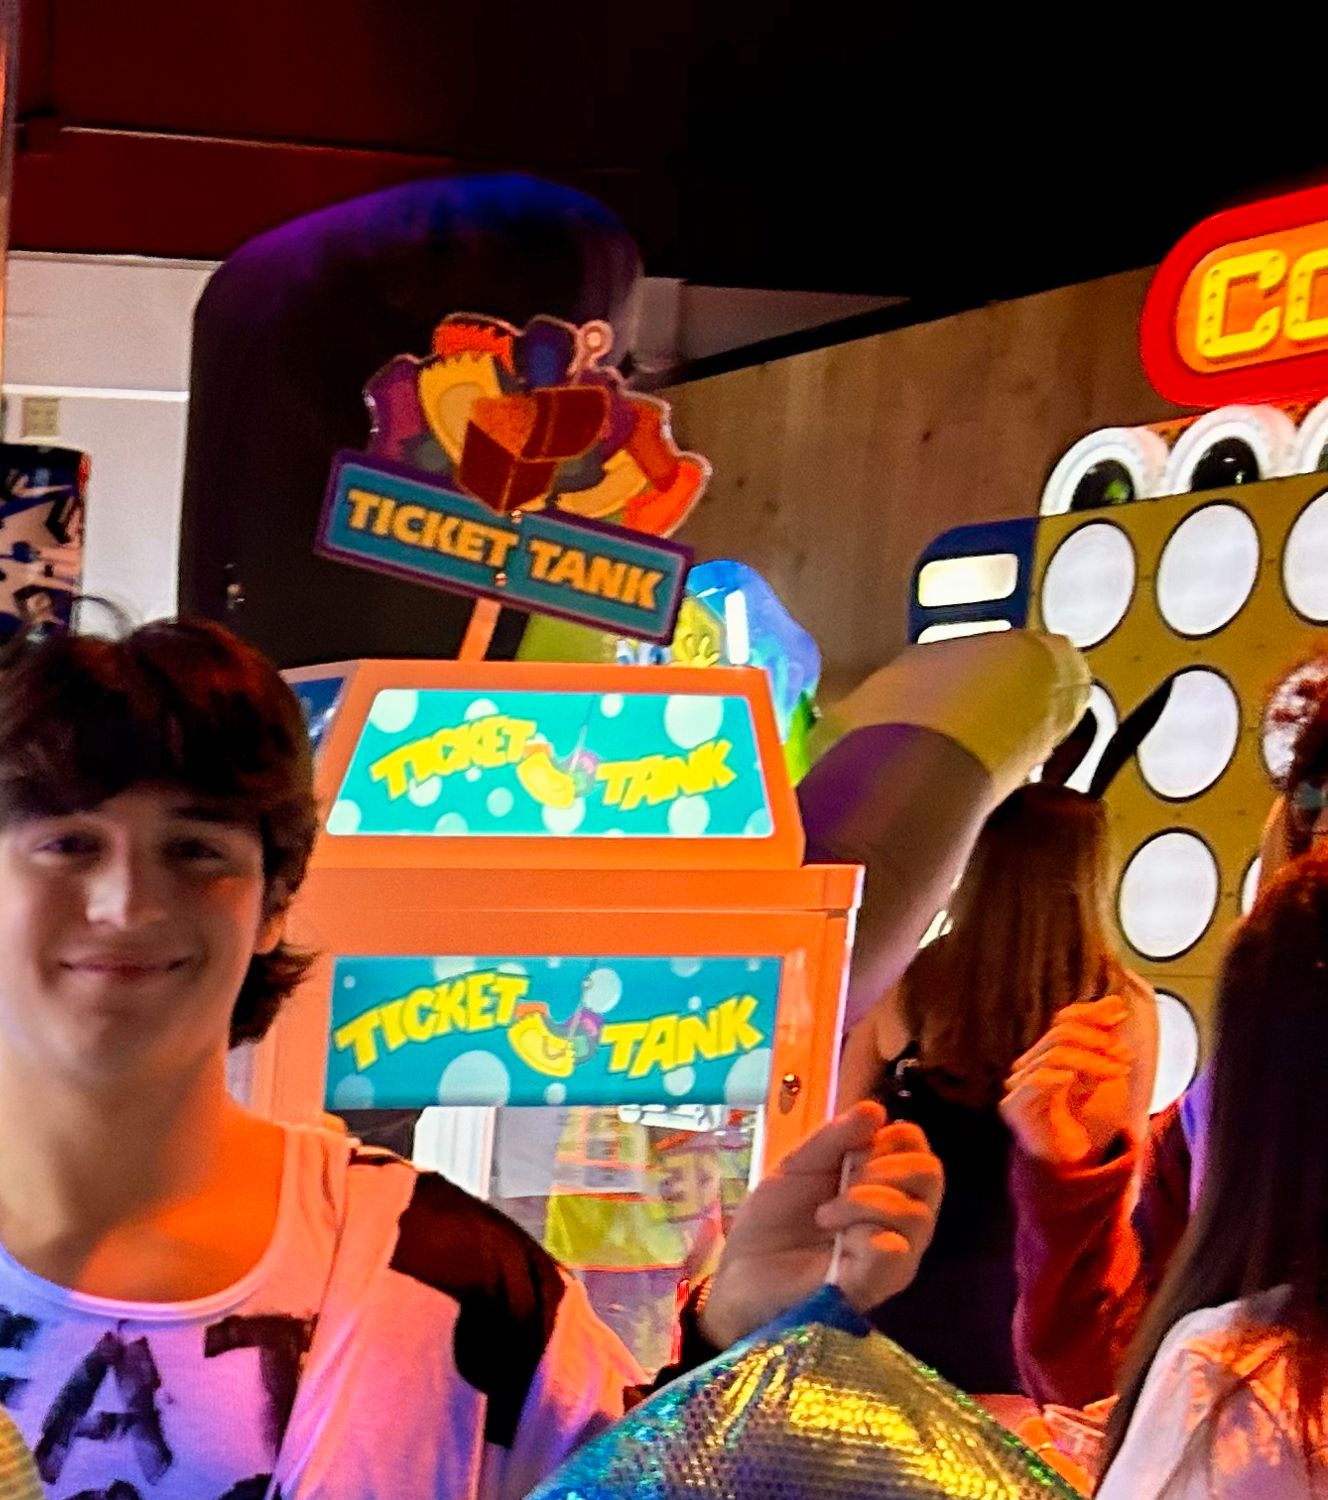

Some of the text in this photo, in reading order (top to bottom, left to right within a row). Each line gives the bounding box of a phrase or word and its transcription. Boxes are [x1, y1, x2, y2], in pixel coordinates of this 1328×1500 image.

[347, 488, 666, 611] TICKET TANK
[369, 715, 738, 811] TICKET TANK
[334, 971, 765, 1080] TICKET TANK
